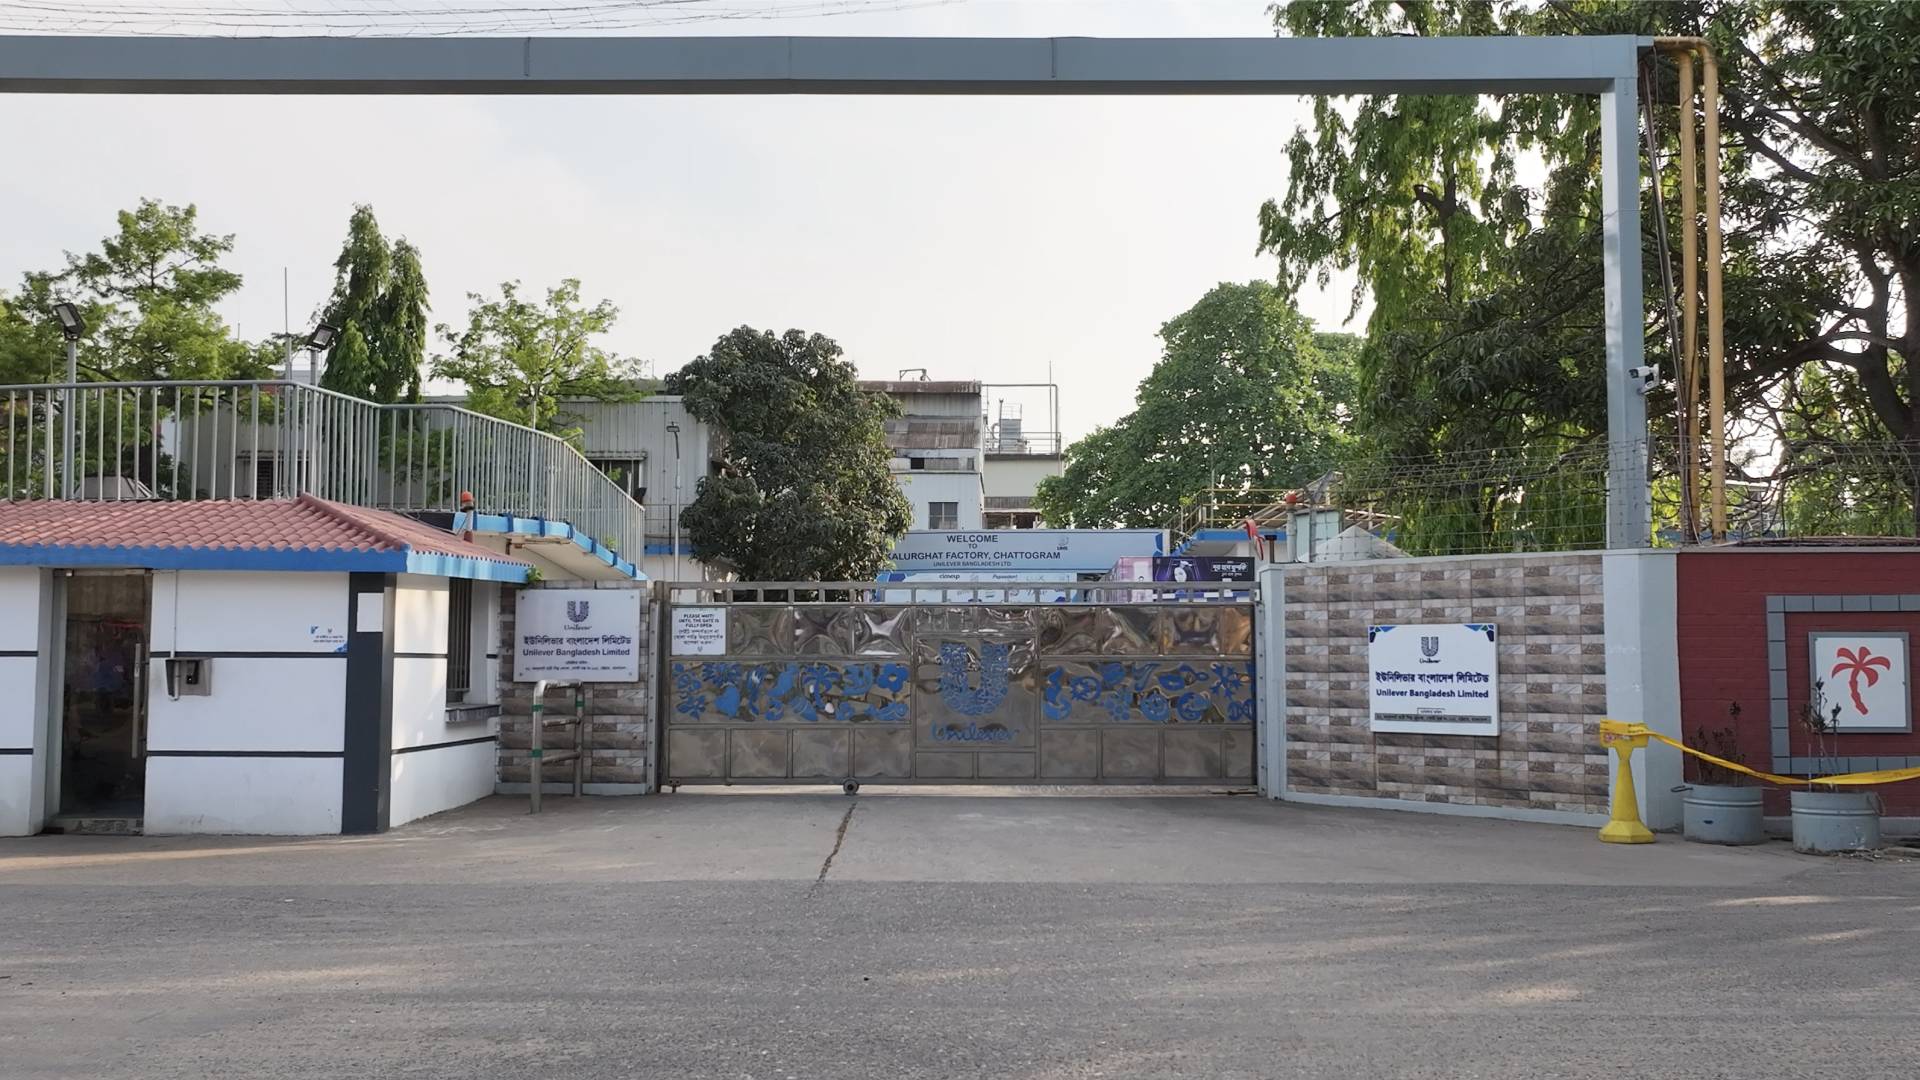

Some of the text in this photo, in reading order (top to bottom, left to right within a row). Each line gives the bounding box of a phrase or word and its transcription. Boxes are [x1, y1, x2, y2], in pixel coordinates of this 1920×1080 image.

[946, 534, 999, 543] WELCOME
[945, 551, 992, 560] FACTORY,
[993, 551, 1061, 560] CHATTOGRAM
[523, 634, 632, 646] ইউনিলিভার বাংলাদেশ লিমিটেড
[522, 648, 630, 657] Unilever Bangladesh Limited
[1375, 671, 1489, 684] ইউনিলিভার বাংলাদেশ লিমিটেড
[1409, 689, 1455, 699] Bangladesh
[1457, 690, 1489, 698] Limited
